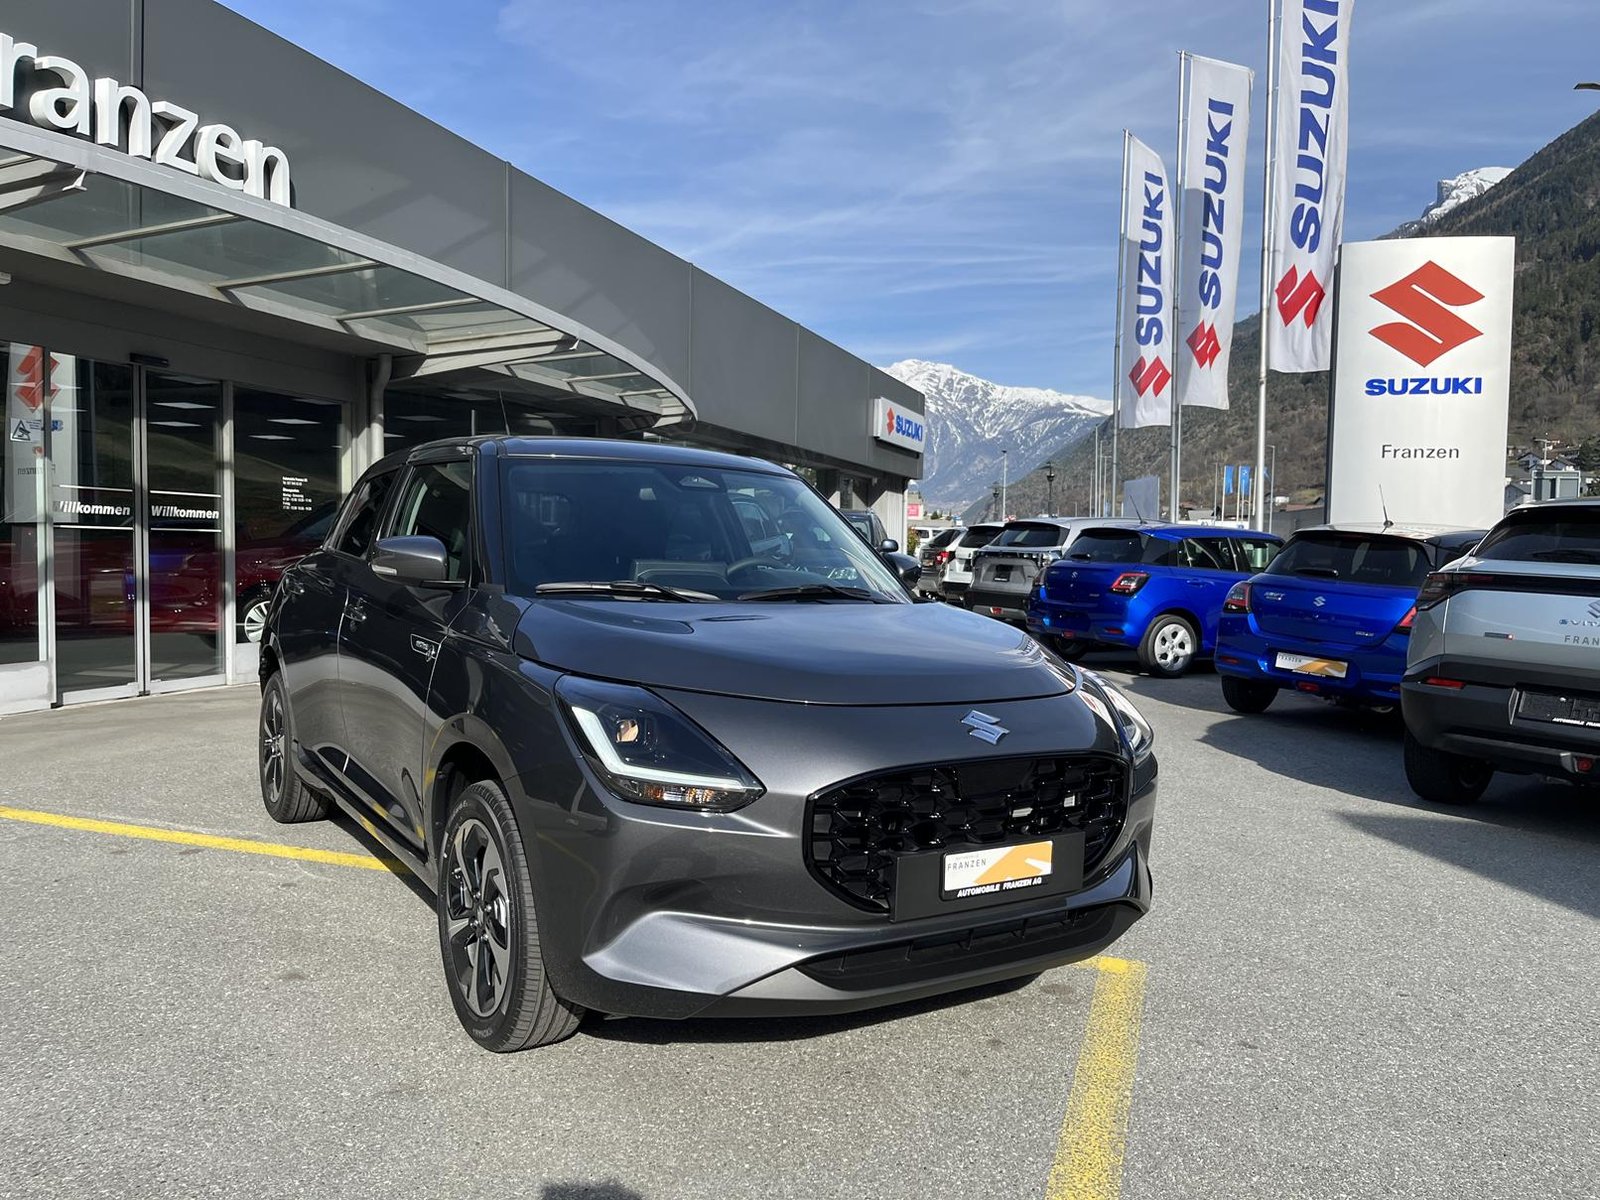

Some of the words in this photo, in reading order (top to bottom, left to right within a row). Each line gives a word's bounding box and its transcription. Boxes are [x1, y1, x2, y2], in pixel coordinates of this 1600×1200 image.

[0, 32, 291, 208] ranzen
[1290, 0, 1339, 253] SUZUKI
[1199, 97, 1235, 310] SUZUKI
[1135, 171, 1164, 346] SUZUKI
[1364, 377, 1482, 396] SUZUKI
[895, 414, 923, 442] SUZUKI
[1381, 444, 1460, 459] Franzen
[151, 505, 220, 519] Willkommen
[947, 859, 987, 872] FRANZEN
[957, 884, 1000, 897] AUTOMOBILE
[1003, 879, 1032, 889] FRANZEN
[1032, 877, 1042, 885] AG
